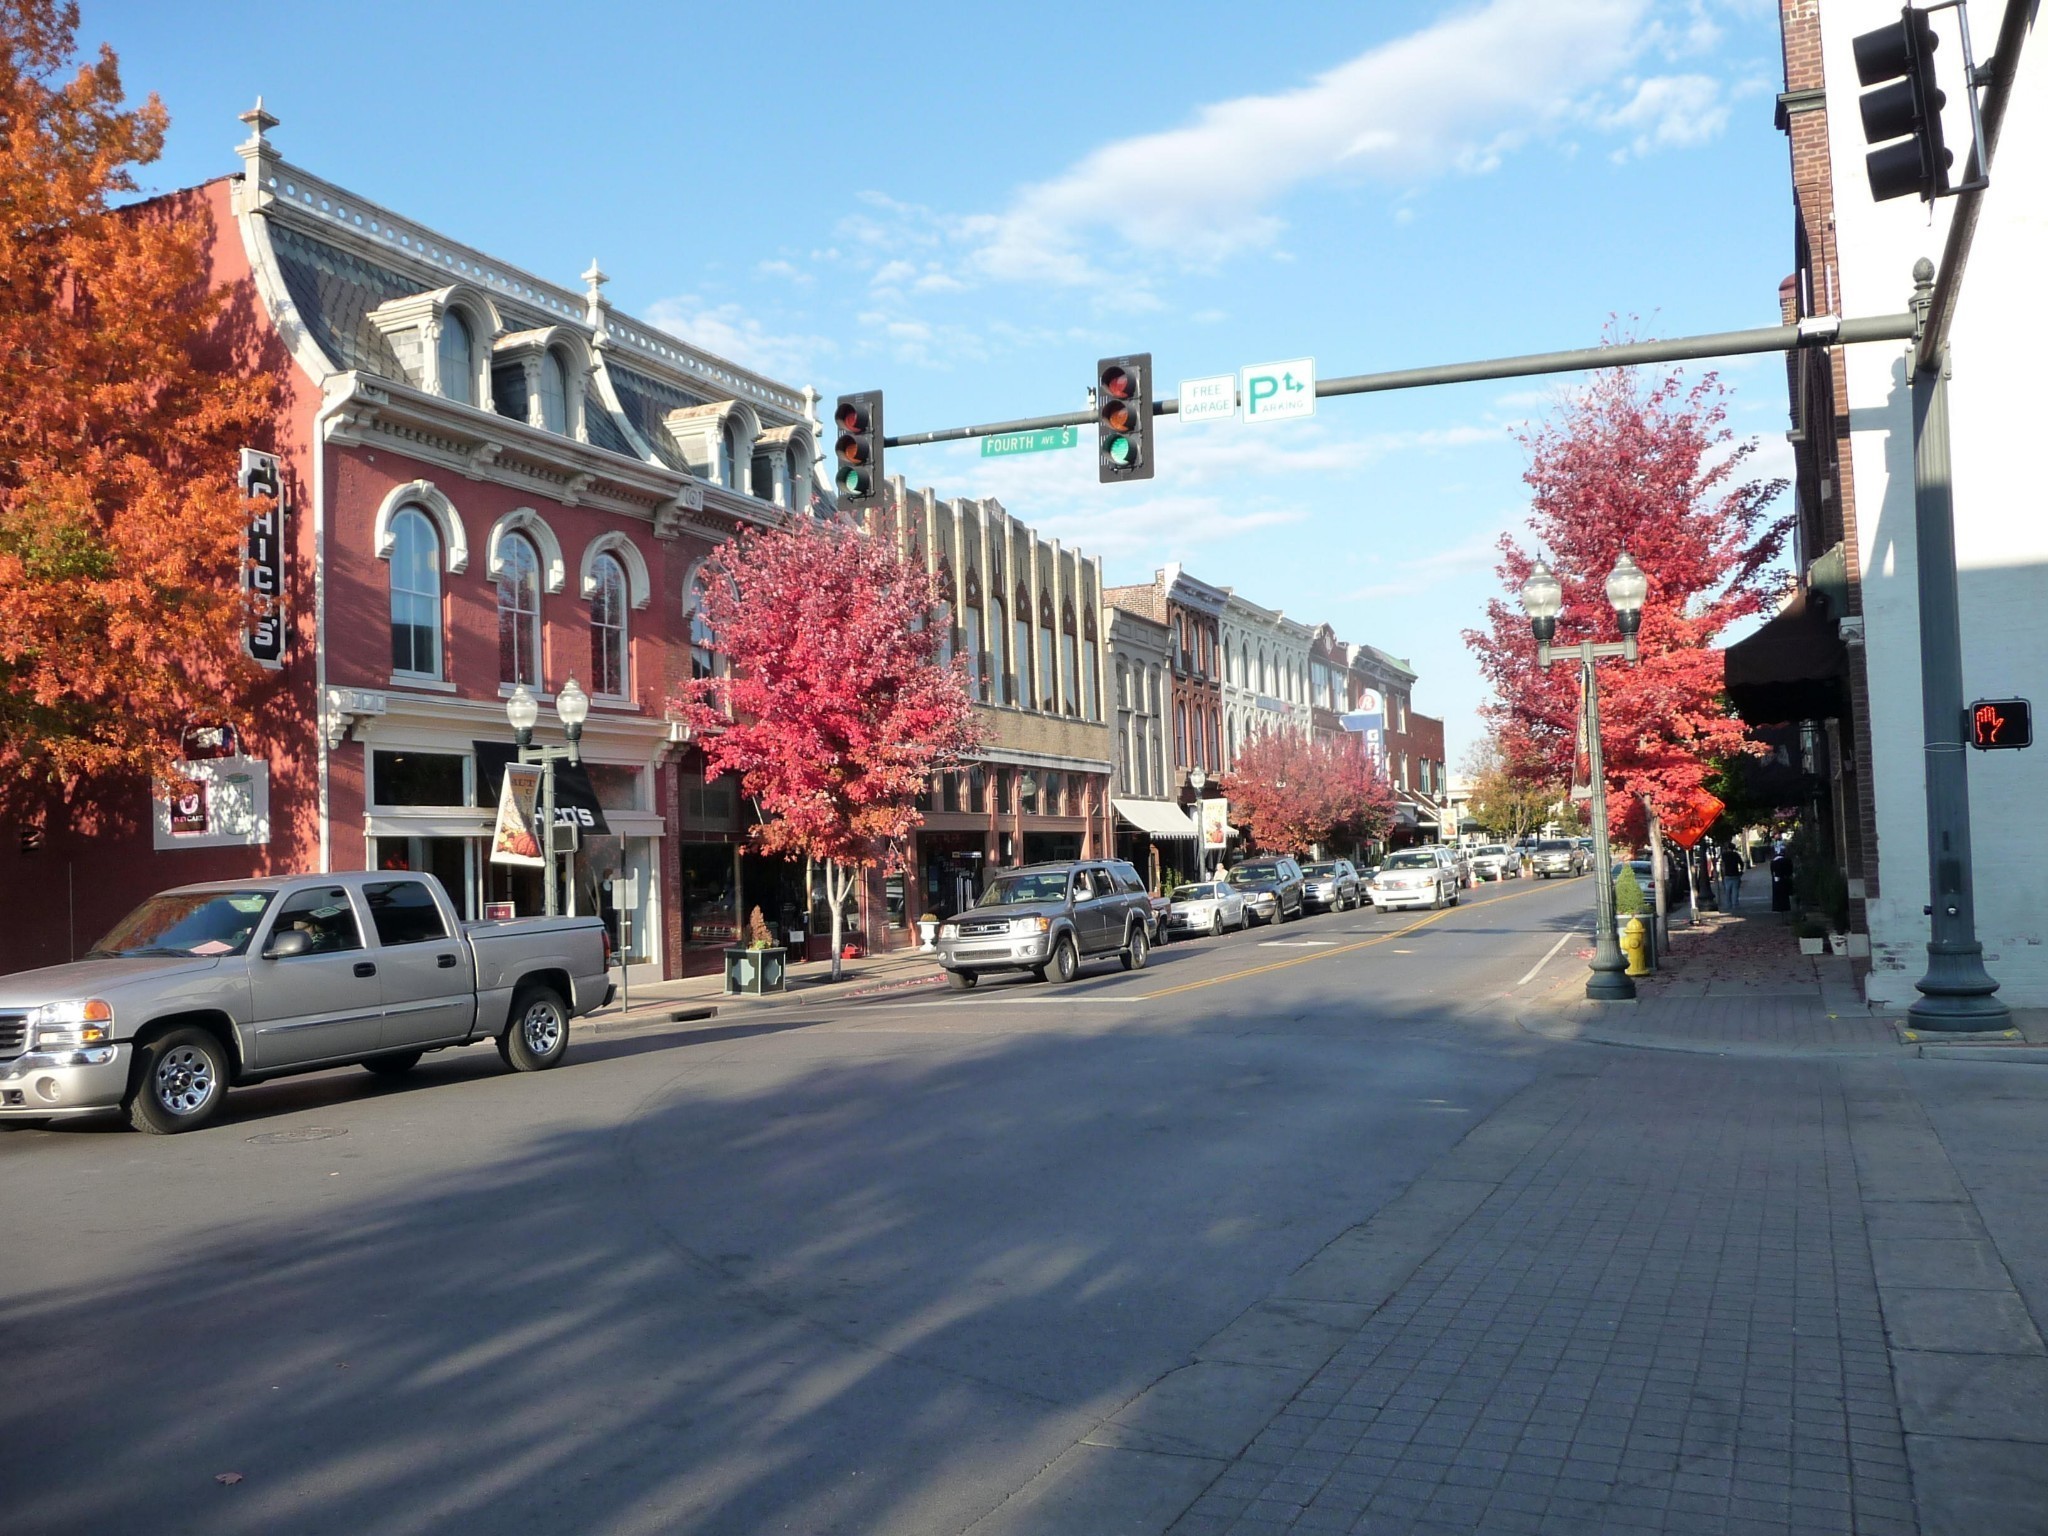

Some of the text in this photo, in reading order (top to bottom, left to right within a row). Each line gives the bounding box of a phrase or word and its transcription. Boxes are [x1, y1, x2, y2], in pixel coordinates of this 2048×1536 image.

[1193, 384, 1222, 398] FREE
[1185, 400, 1231, 415] GARAGE
[987, 431, 1070, 454] FOURTH AVE S
